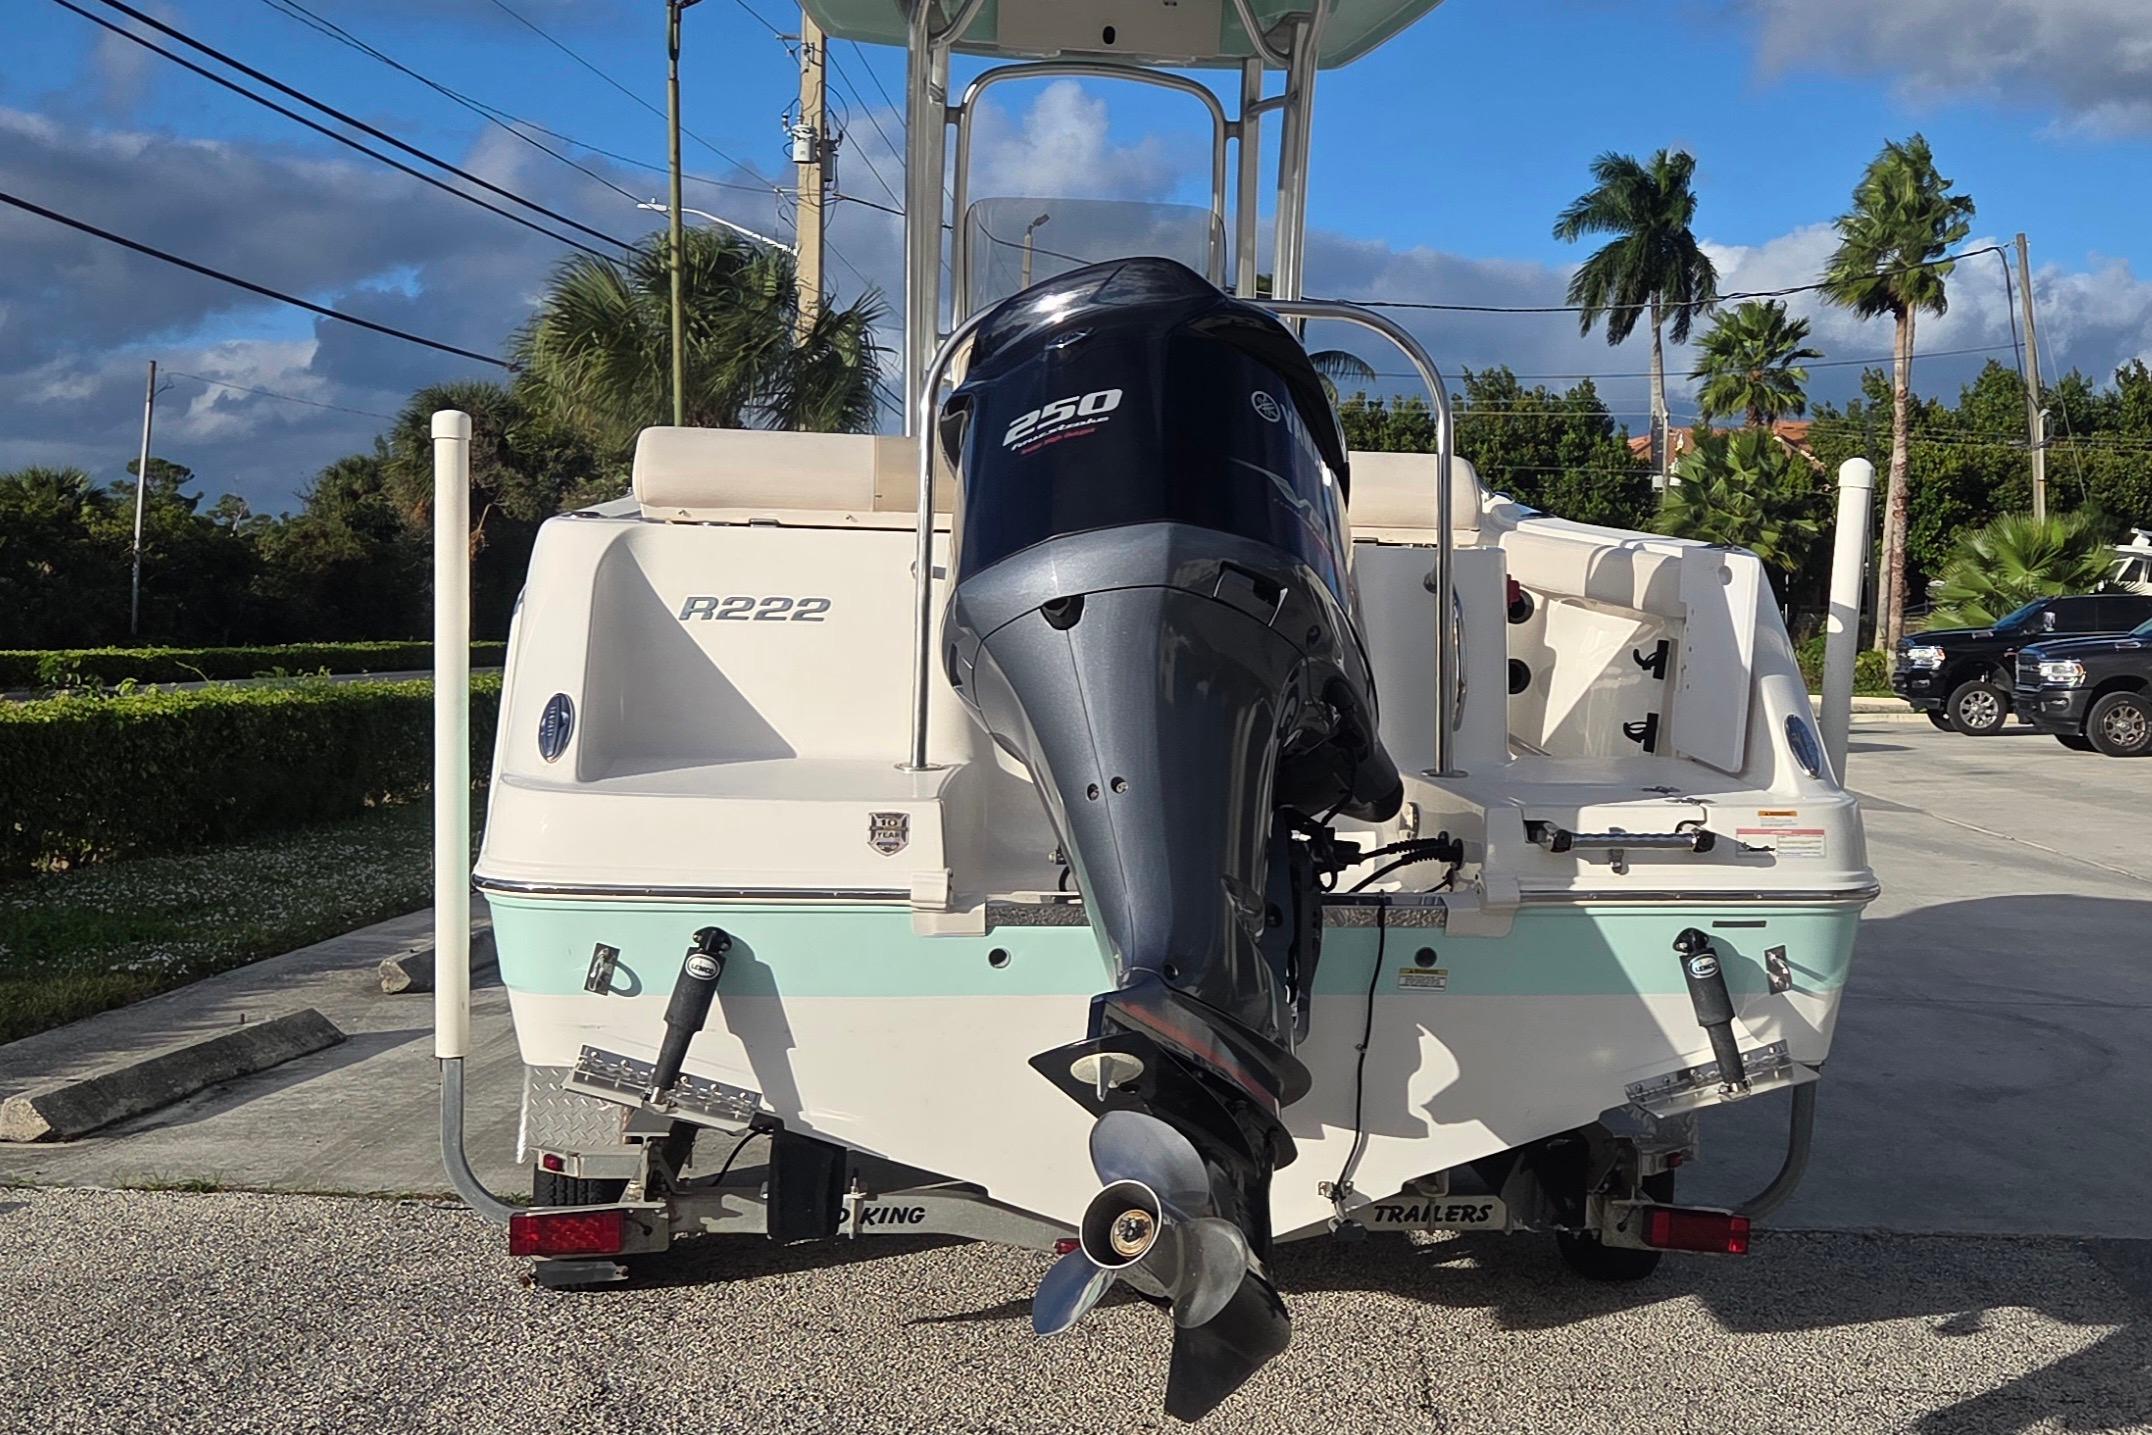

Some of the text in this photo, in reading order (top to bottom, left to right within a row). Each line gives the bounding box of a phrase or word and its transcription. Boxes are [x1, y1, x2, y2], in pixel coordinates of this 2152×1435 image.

[1003, 389, 1122, 446] 250
[679, 597, 831, 622] R222
[860, 1207, 926, 1225] KING
[1374, 1204, 1493, 1223] TRAILERS
